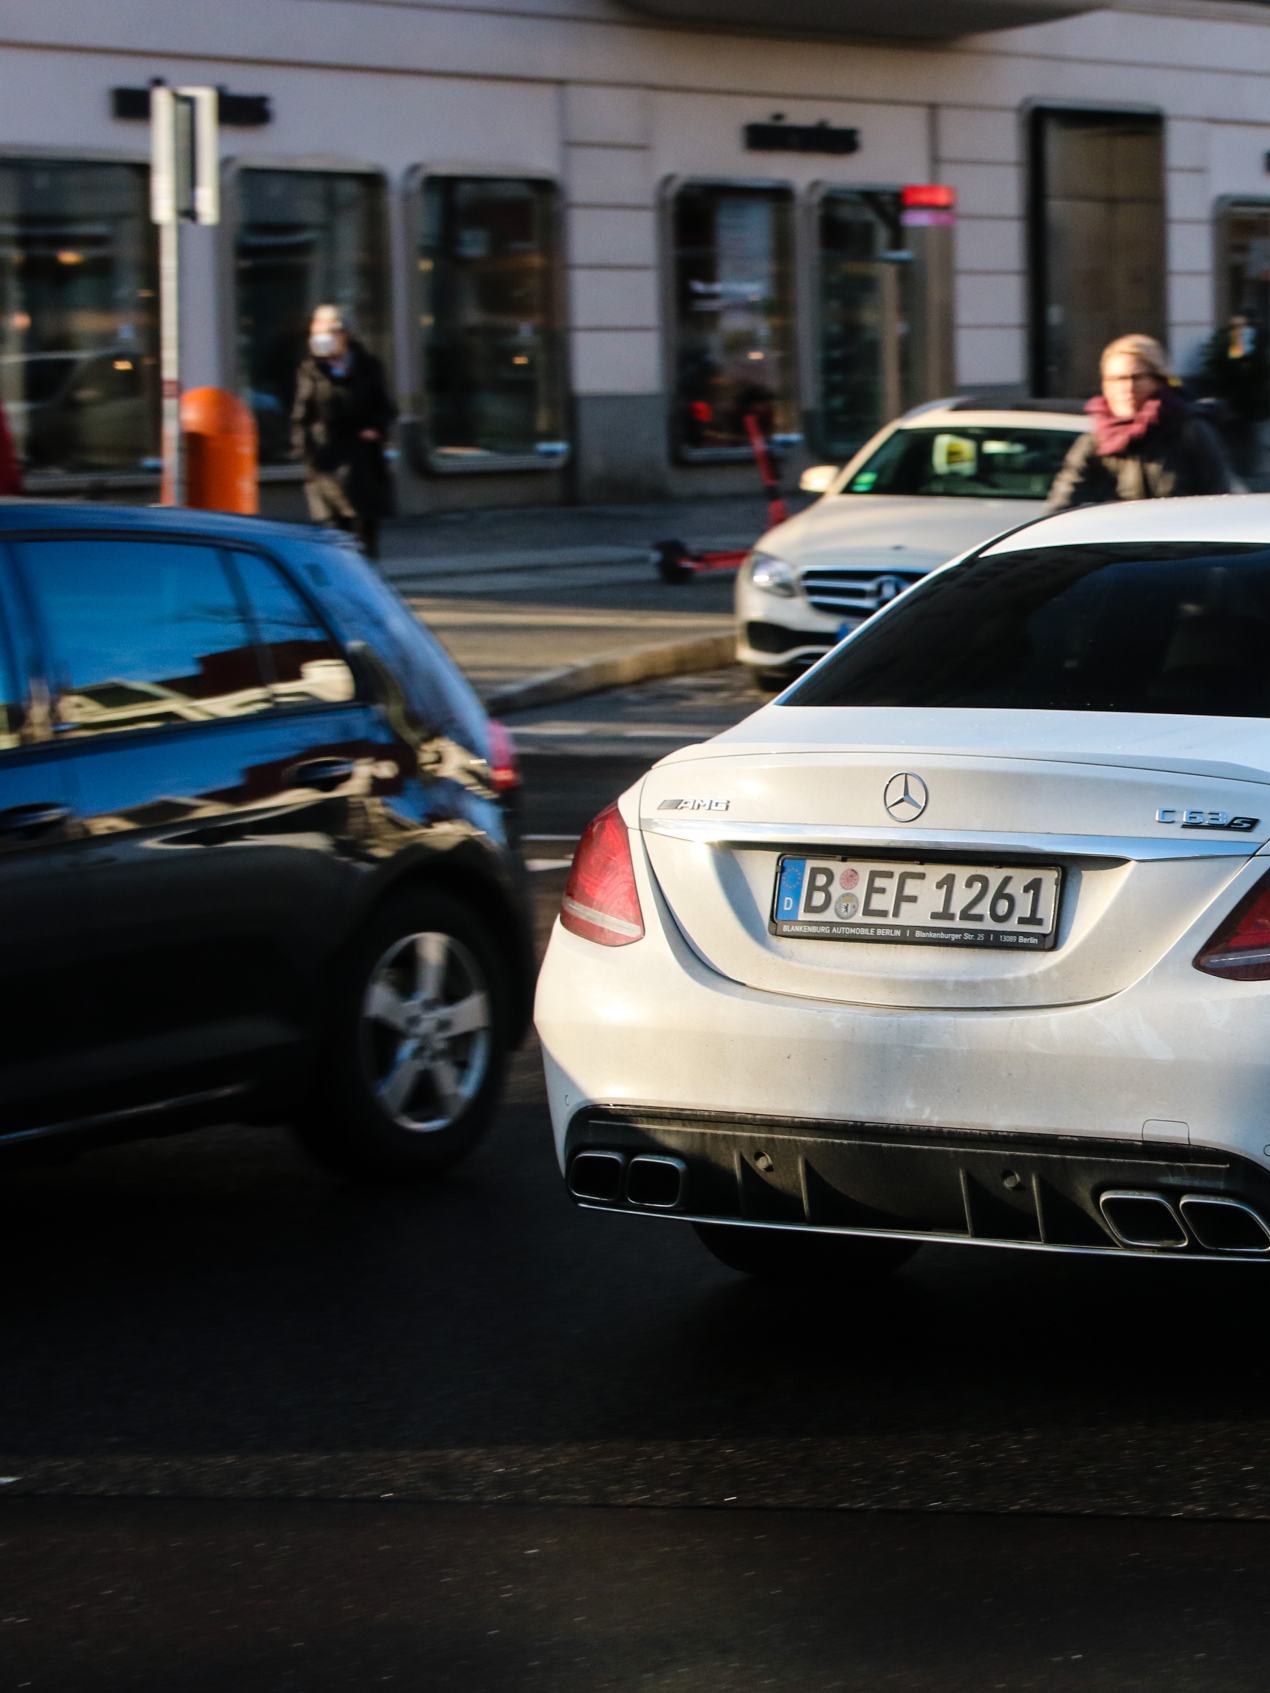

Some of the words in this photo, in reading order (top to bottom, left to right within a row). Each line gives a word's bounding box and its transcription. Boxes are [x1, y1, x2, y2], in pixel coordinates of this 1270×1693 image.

[677, 799, 730, 811] AMG
[783, 897, 793, 910] D
[803, 867, 834, 914] B
[930, 873, 1043, 926] 1261
[783, 924, 830, 933] BLANKENBURG
[832, 927, 874, 936] AUTOMOBILE
[876, 929, 901, 937] BERLIN
[915, 930, 962, 941] Blankenburger
[963, 932, 976, 941] Str.
[1000, 935, 1017, 943] 13089
[1018, 936, 1039, 944] Berlin
